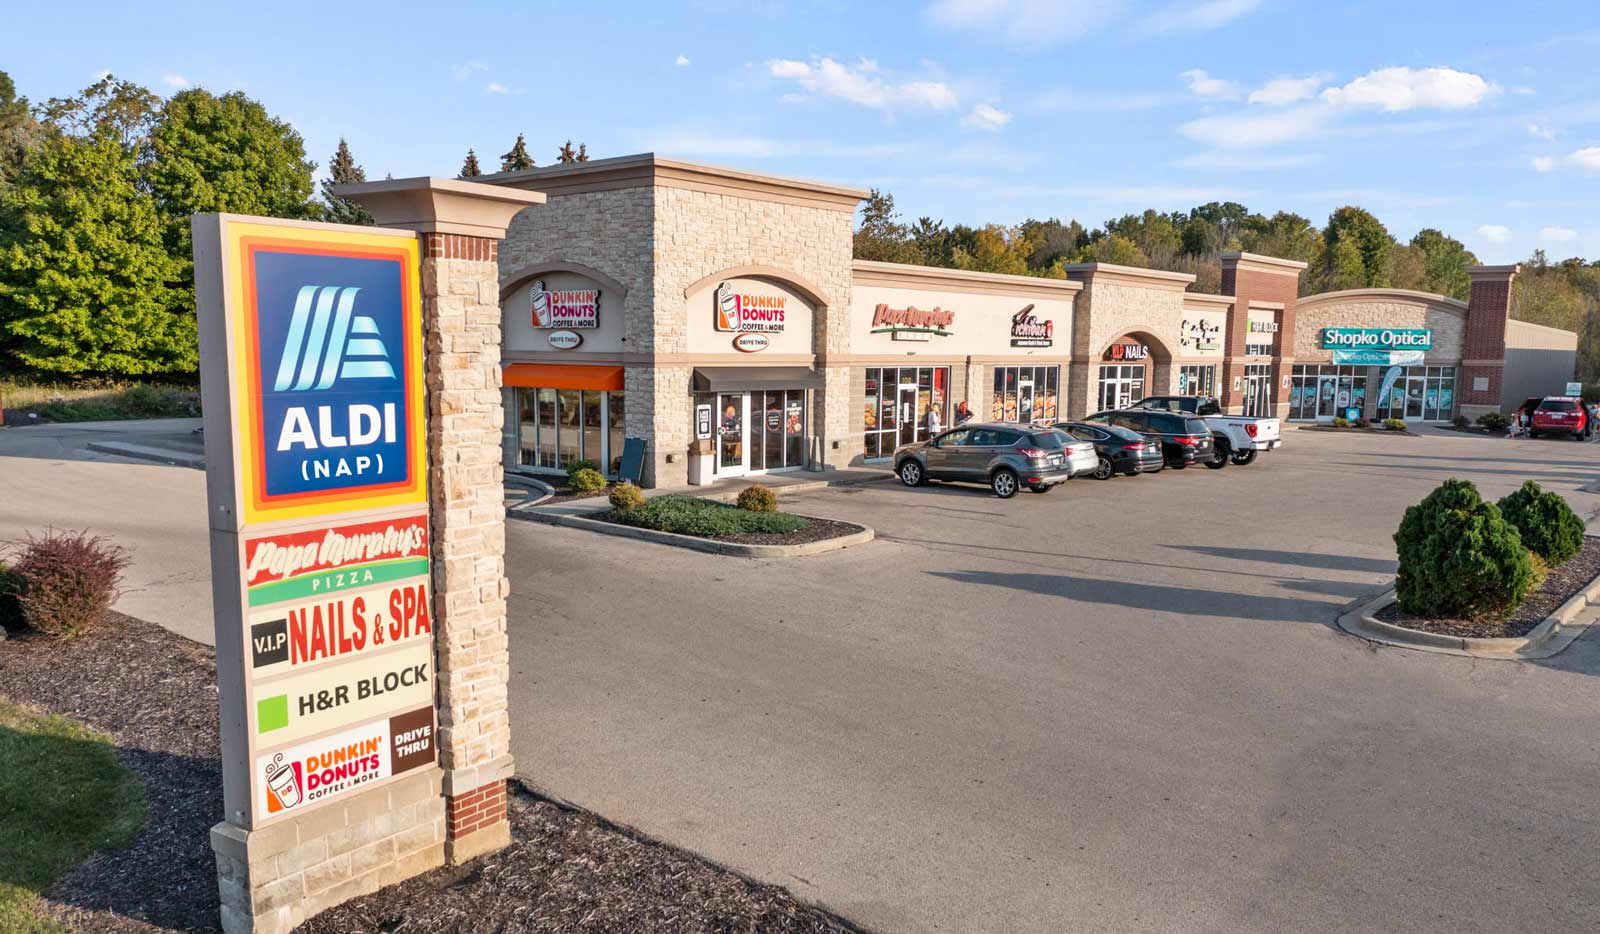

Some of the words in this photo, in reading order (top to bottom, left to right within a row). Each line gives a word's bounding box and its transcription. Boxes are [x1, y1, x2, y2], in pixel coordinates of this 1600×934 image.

[553, 304, 595, 318] DONUTS
[742, 308, 785, 322] DONUTS
[578, 319, 595, 327] MORE
[742, 323, 764, 331] COFFEE
[768, 324, 785, 332] MORE
[1325, 330, 1379, 346] Shopko
[1380, 331, 1431, 347] Optical
[1125, 345, 1149, 359] NAILS
[277, 403, 396, 451] ALDI
[301, 454, 384, 481] (NAP)
[247, 542, 320, 579] Papa
[312, 569, 374, 591] PIZZA
[254, 632, 287, 654] V.I.P
[289, 596, 368, 665] NAILS
[373, 613, 385, 646] &
[389, 584, 431, 641] SPA
[298, 685, 350, 717] H&R
[357, 664, 428, 700] BLOCK
[394, 725, 431, 747] DRIVE
[306, 736, 382, 774] DUNKIN'
[396, 739, 430, 758] THRU
[307, 753, 380, 791] DONUTS
[308, 782, 345, 801] COFFEE
[353, 770, 380, 785] MORE
